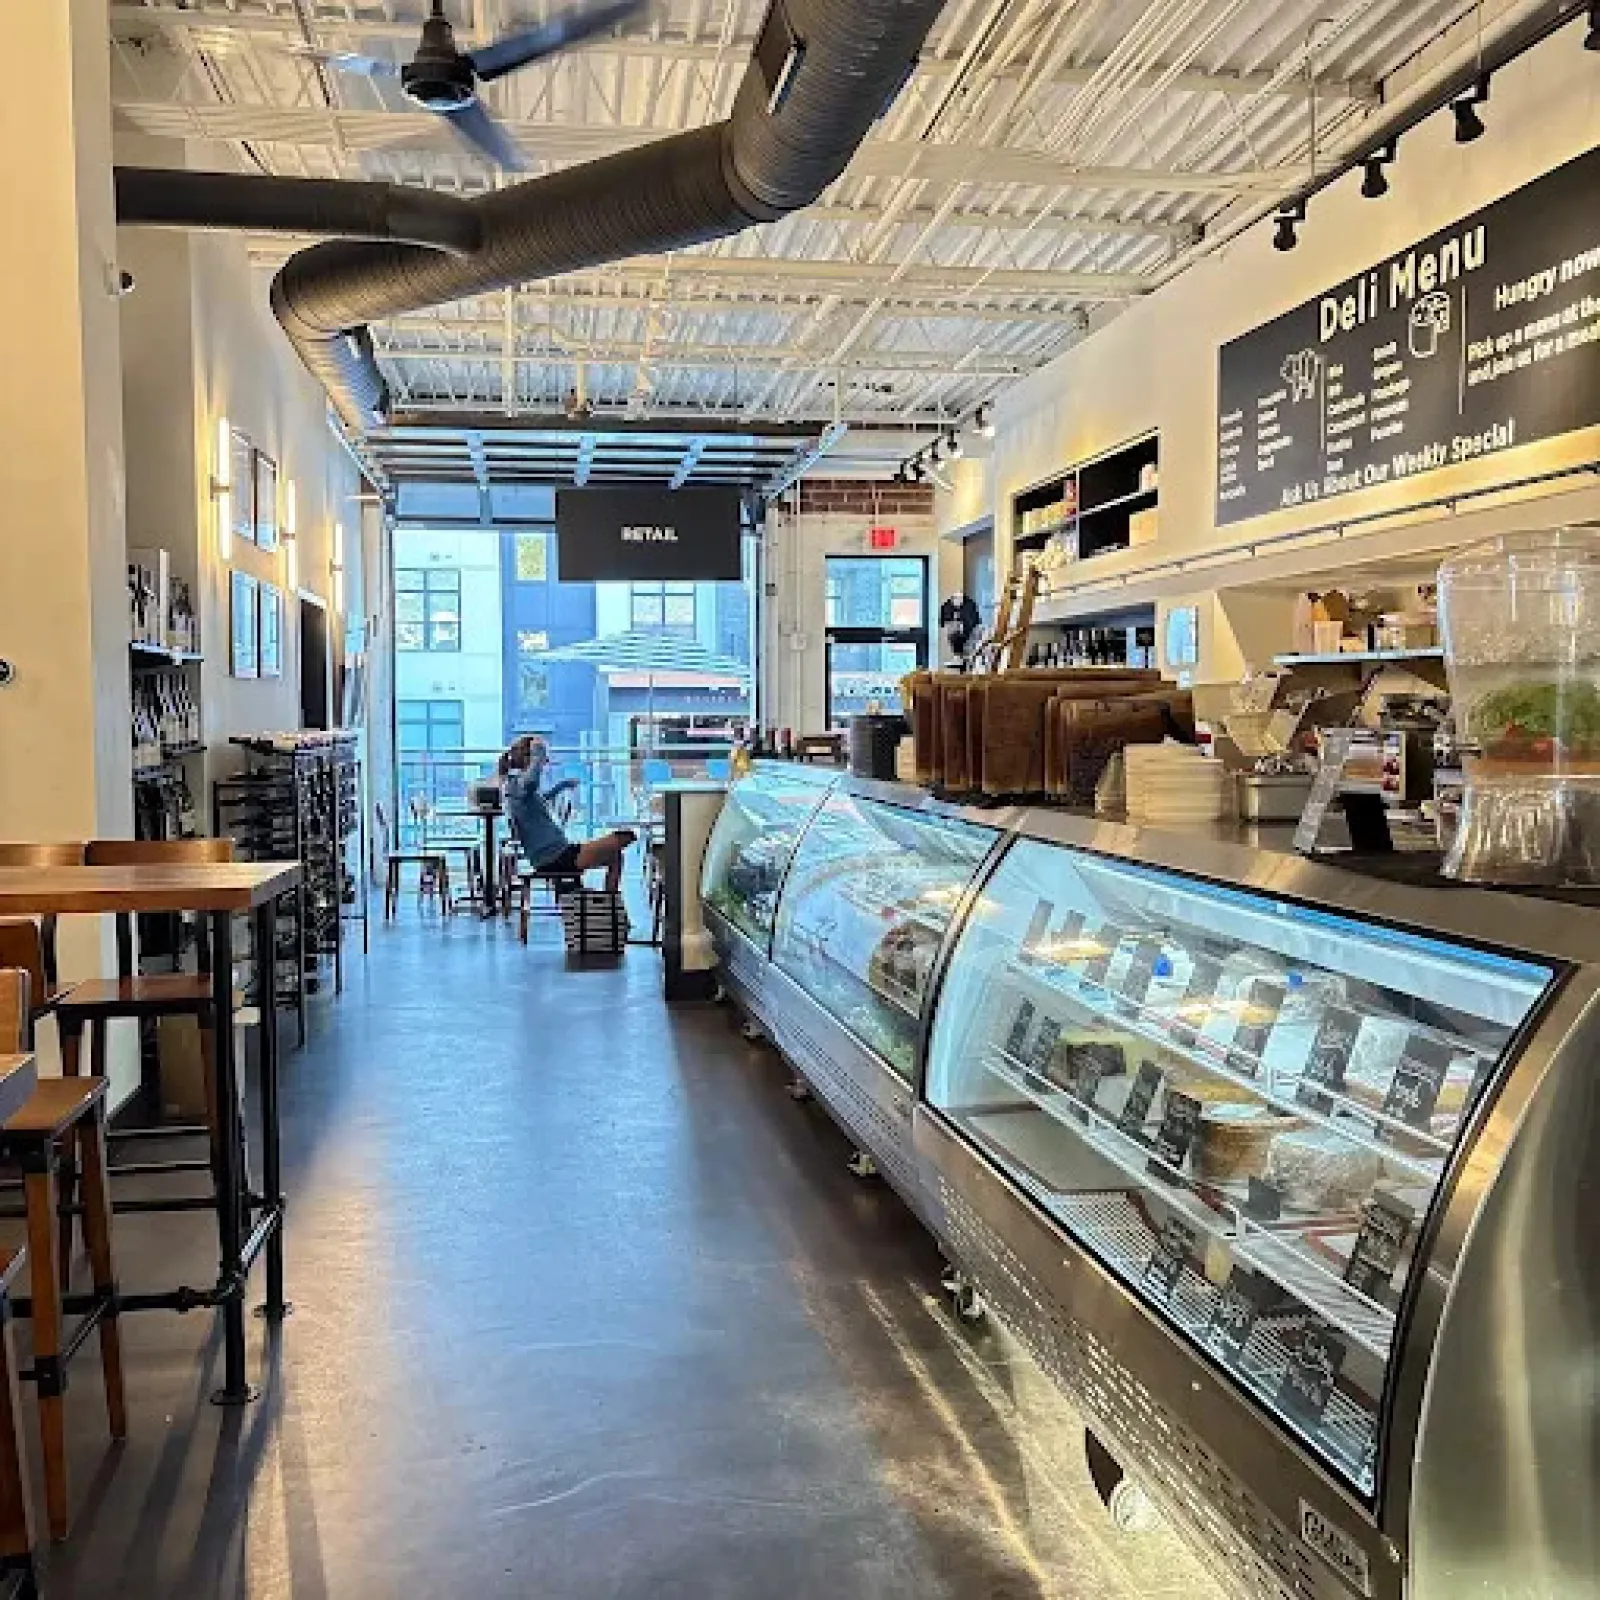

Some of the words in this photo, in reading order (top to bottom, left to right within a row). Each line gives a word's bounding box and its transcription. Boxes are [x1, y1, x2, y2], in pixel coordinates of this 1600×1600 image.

[1320, 272, 1378, 342] Deli
[1389, 225, 1485, 309] Menu
[1494, 266, 1557, 311] Hungry
[1364, 463, 1390, 485] Our
[1393, 441, 1448, 478] Weekly
[1452, 416, 1516, 462] Special
[620, 526, 679, 543] RETAIL
